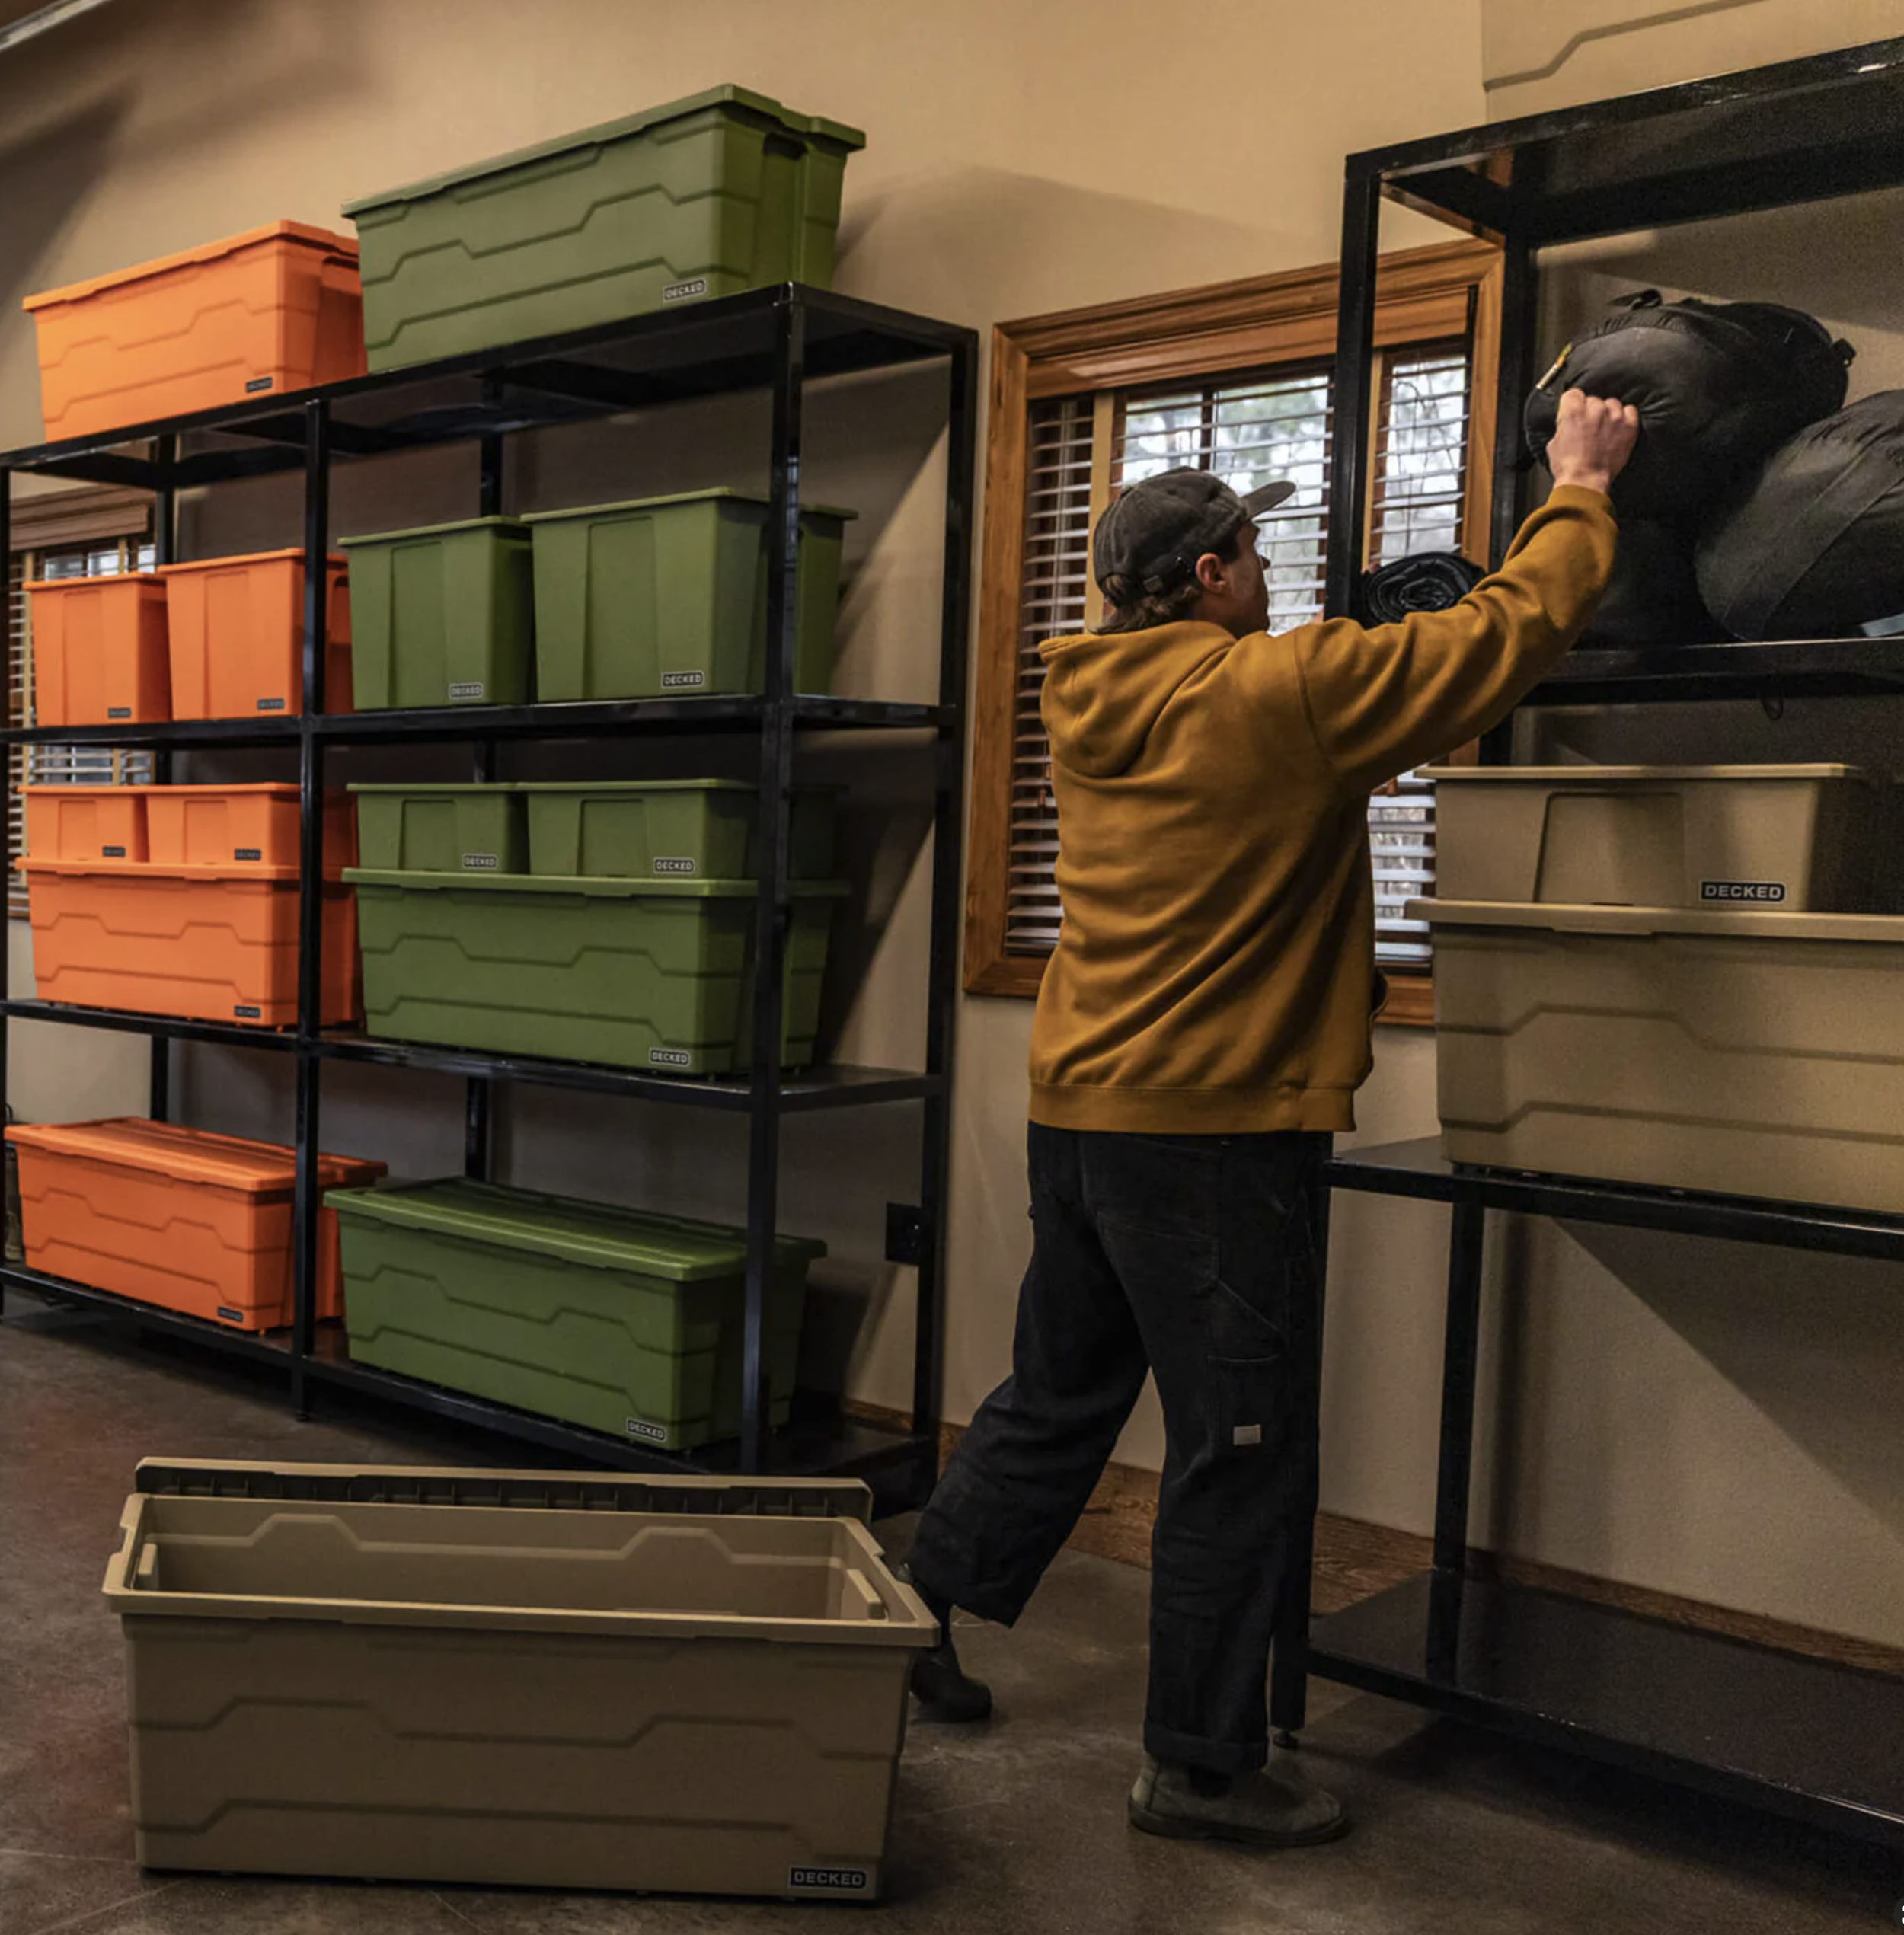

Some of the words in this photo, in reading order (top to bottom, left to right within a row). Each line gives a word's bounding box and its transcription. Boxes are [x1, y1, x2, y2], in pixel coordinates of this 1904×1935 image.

[666, 282, 704, 299] DECKED
[665, 675, 701, 685] DECKED
[465, 857, 495, 866] DECKED
[656, 861, 692, 870] DECKED
[1704, 883, 1781, 898] DECKED
[652, 1052, 687, 1064] DECKED
[629, 1421, 664, 1438] DECKED
[794, 1870, 864, 1885] DECKED
